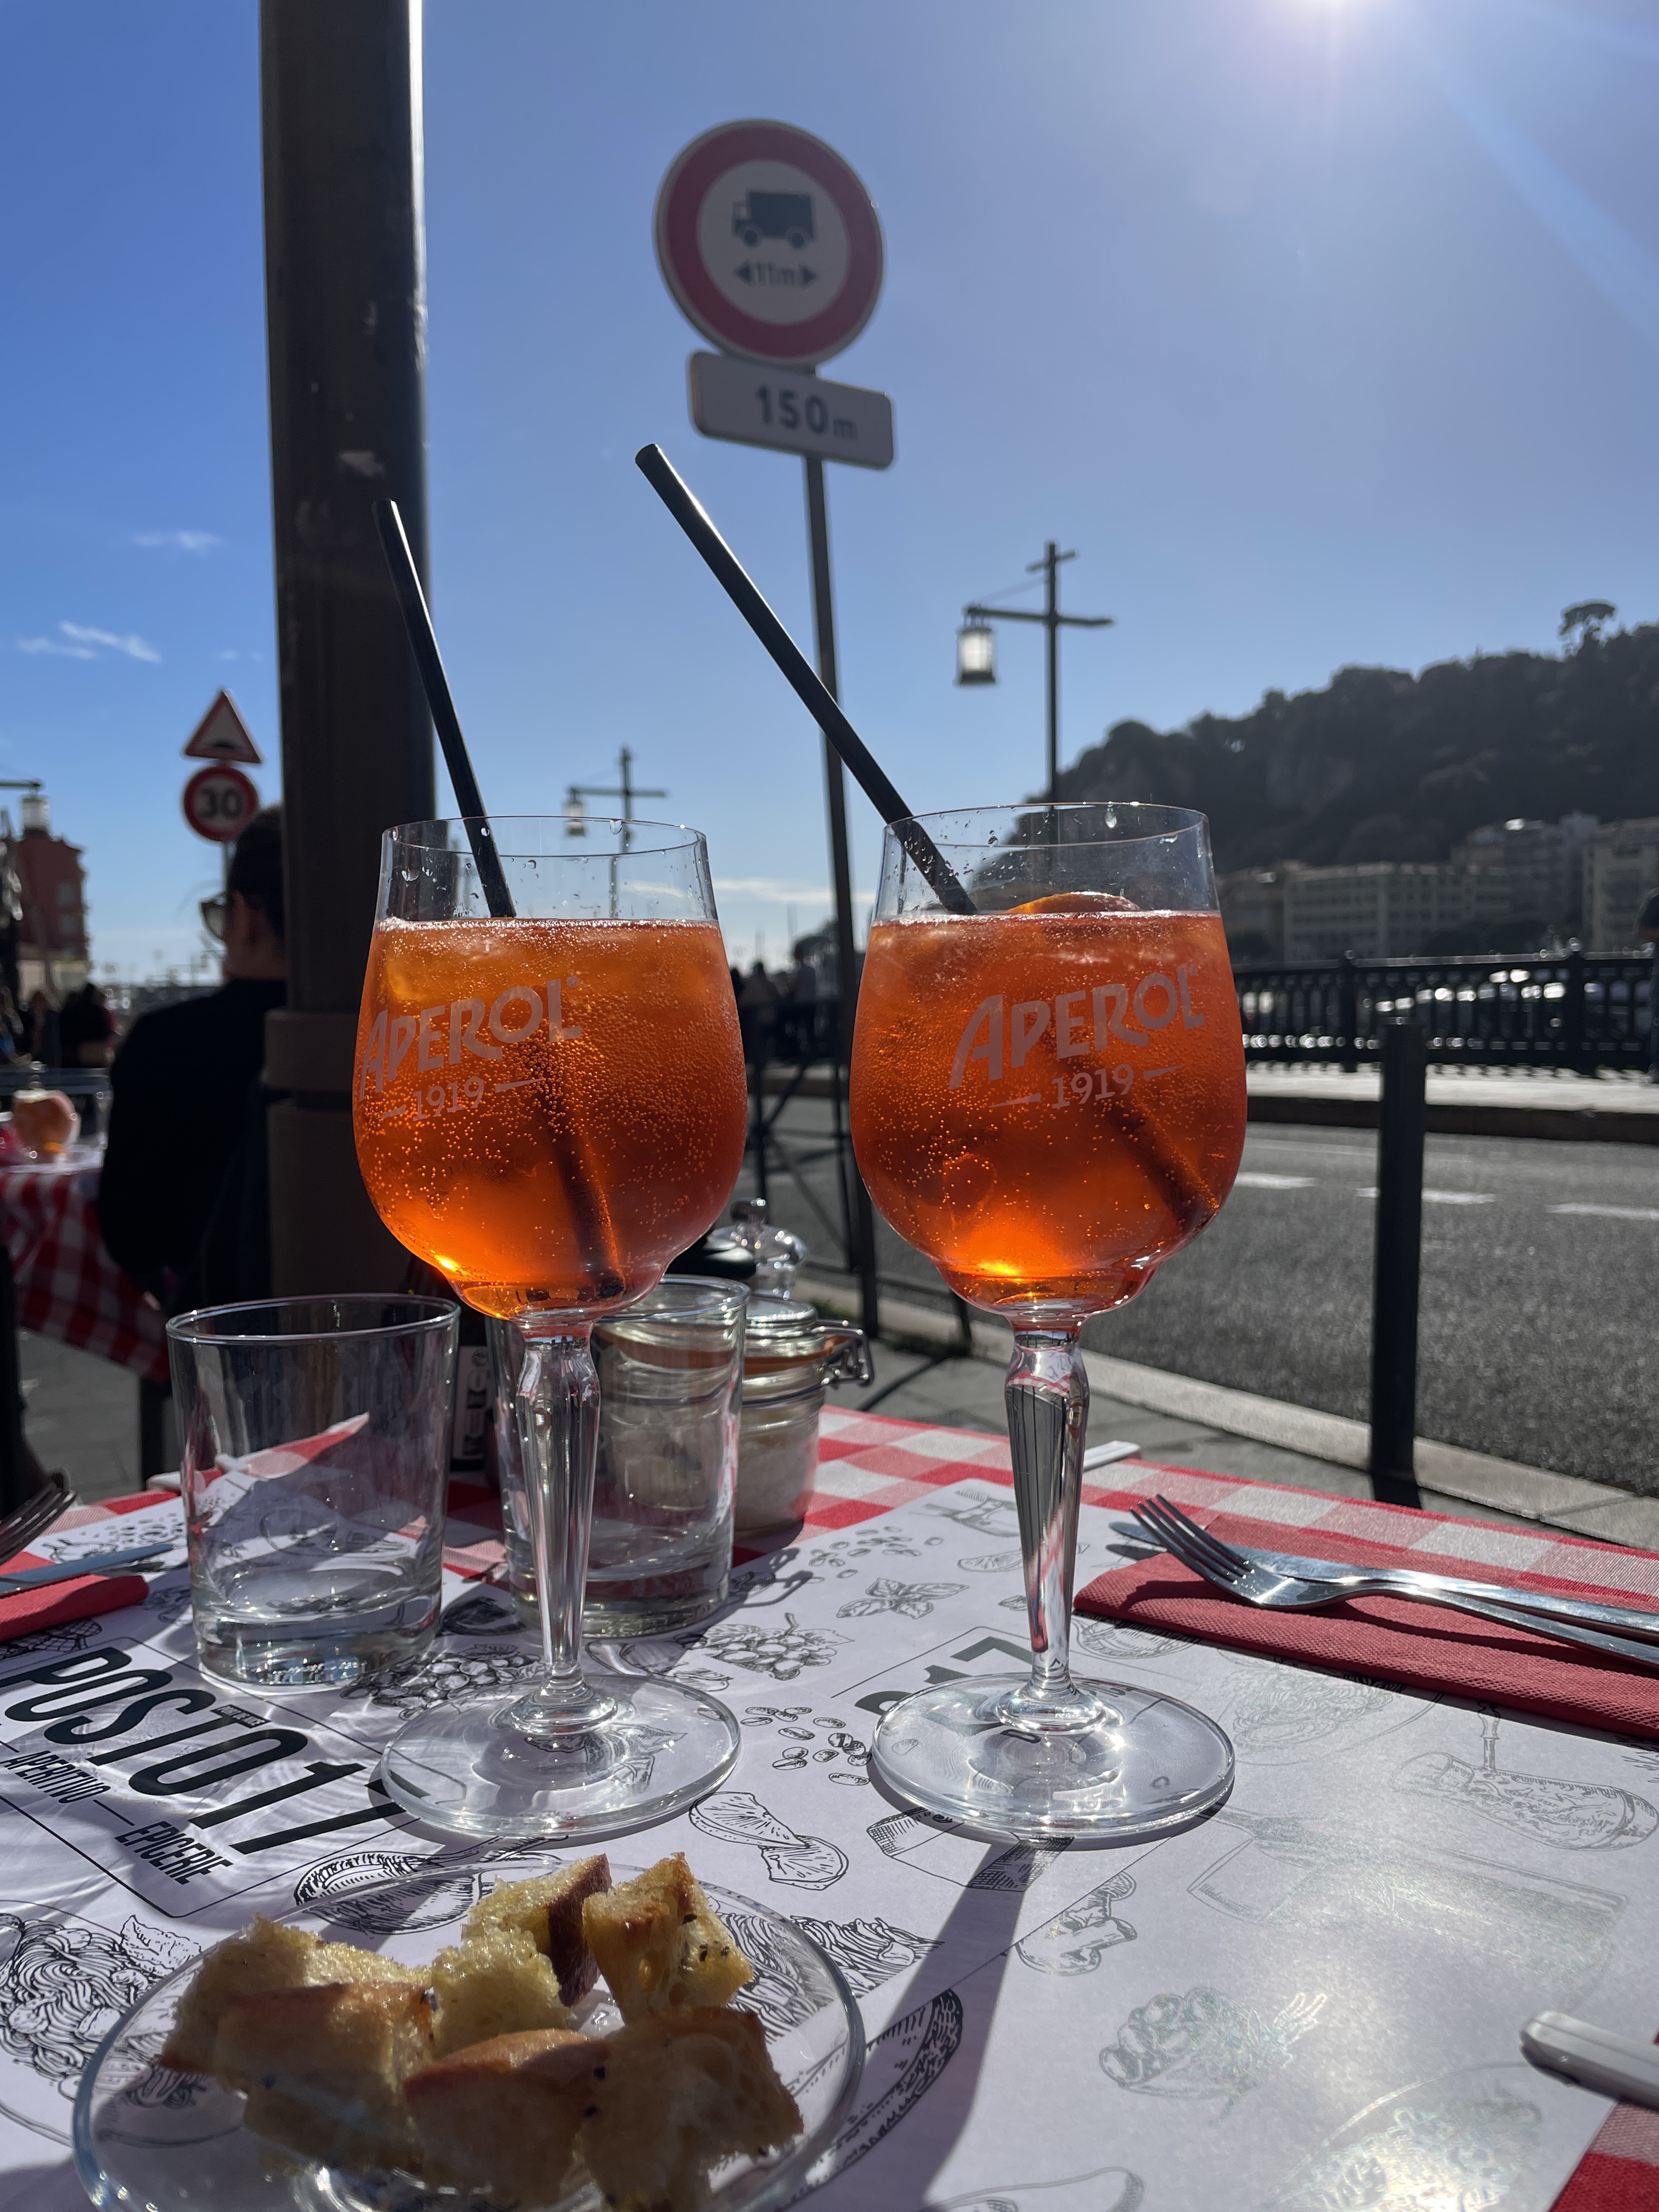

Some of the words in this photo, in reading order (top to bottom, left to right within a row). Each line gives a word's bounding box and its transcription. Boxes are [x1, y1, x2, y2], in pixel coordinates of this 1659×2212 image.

[200, 788, 242, 819] 30
[412, 1076, 485, 1122] 1919
[1051, 1063, 1134, 1109] 1919
[0, 1750, 111, 1803] APERITIVO
[114, 1821, 234, 1885] EPICERIE
